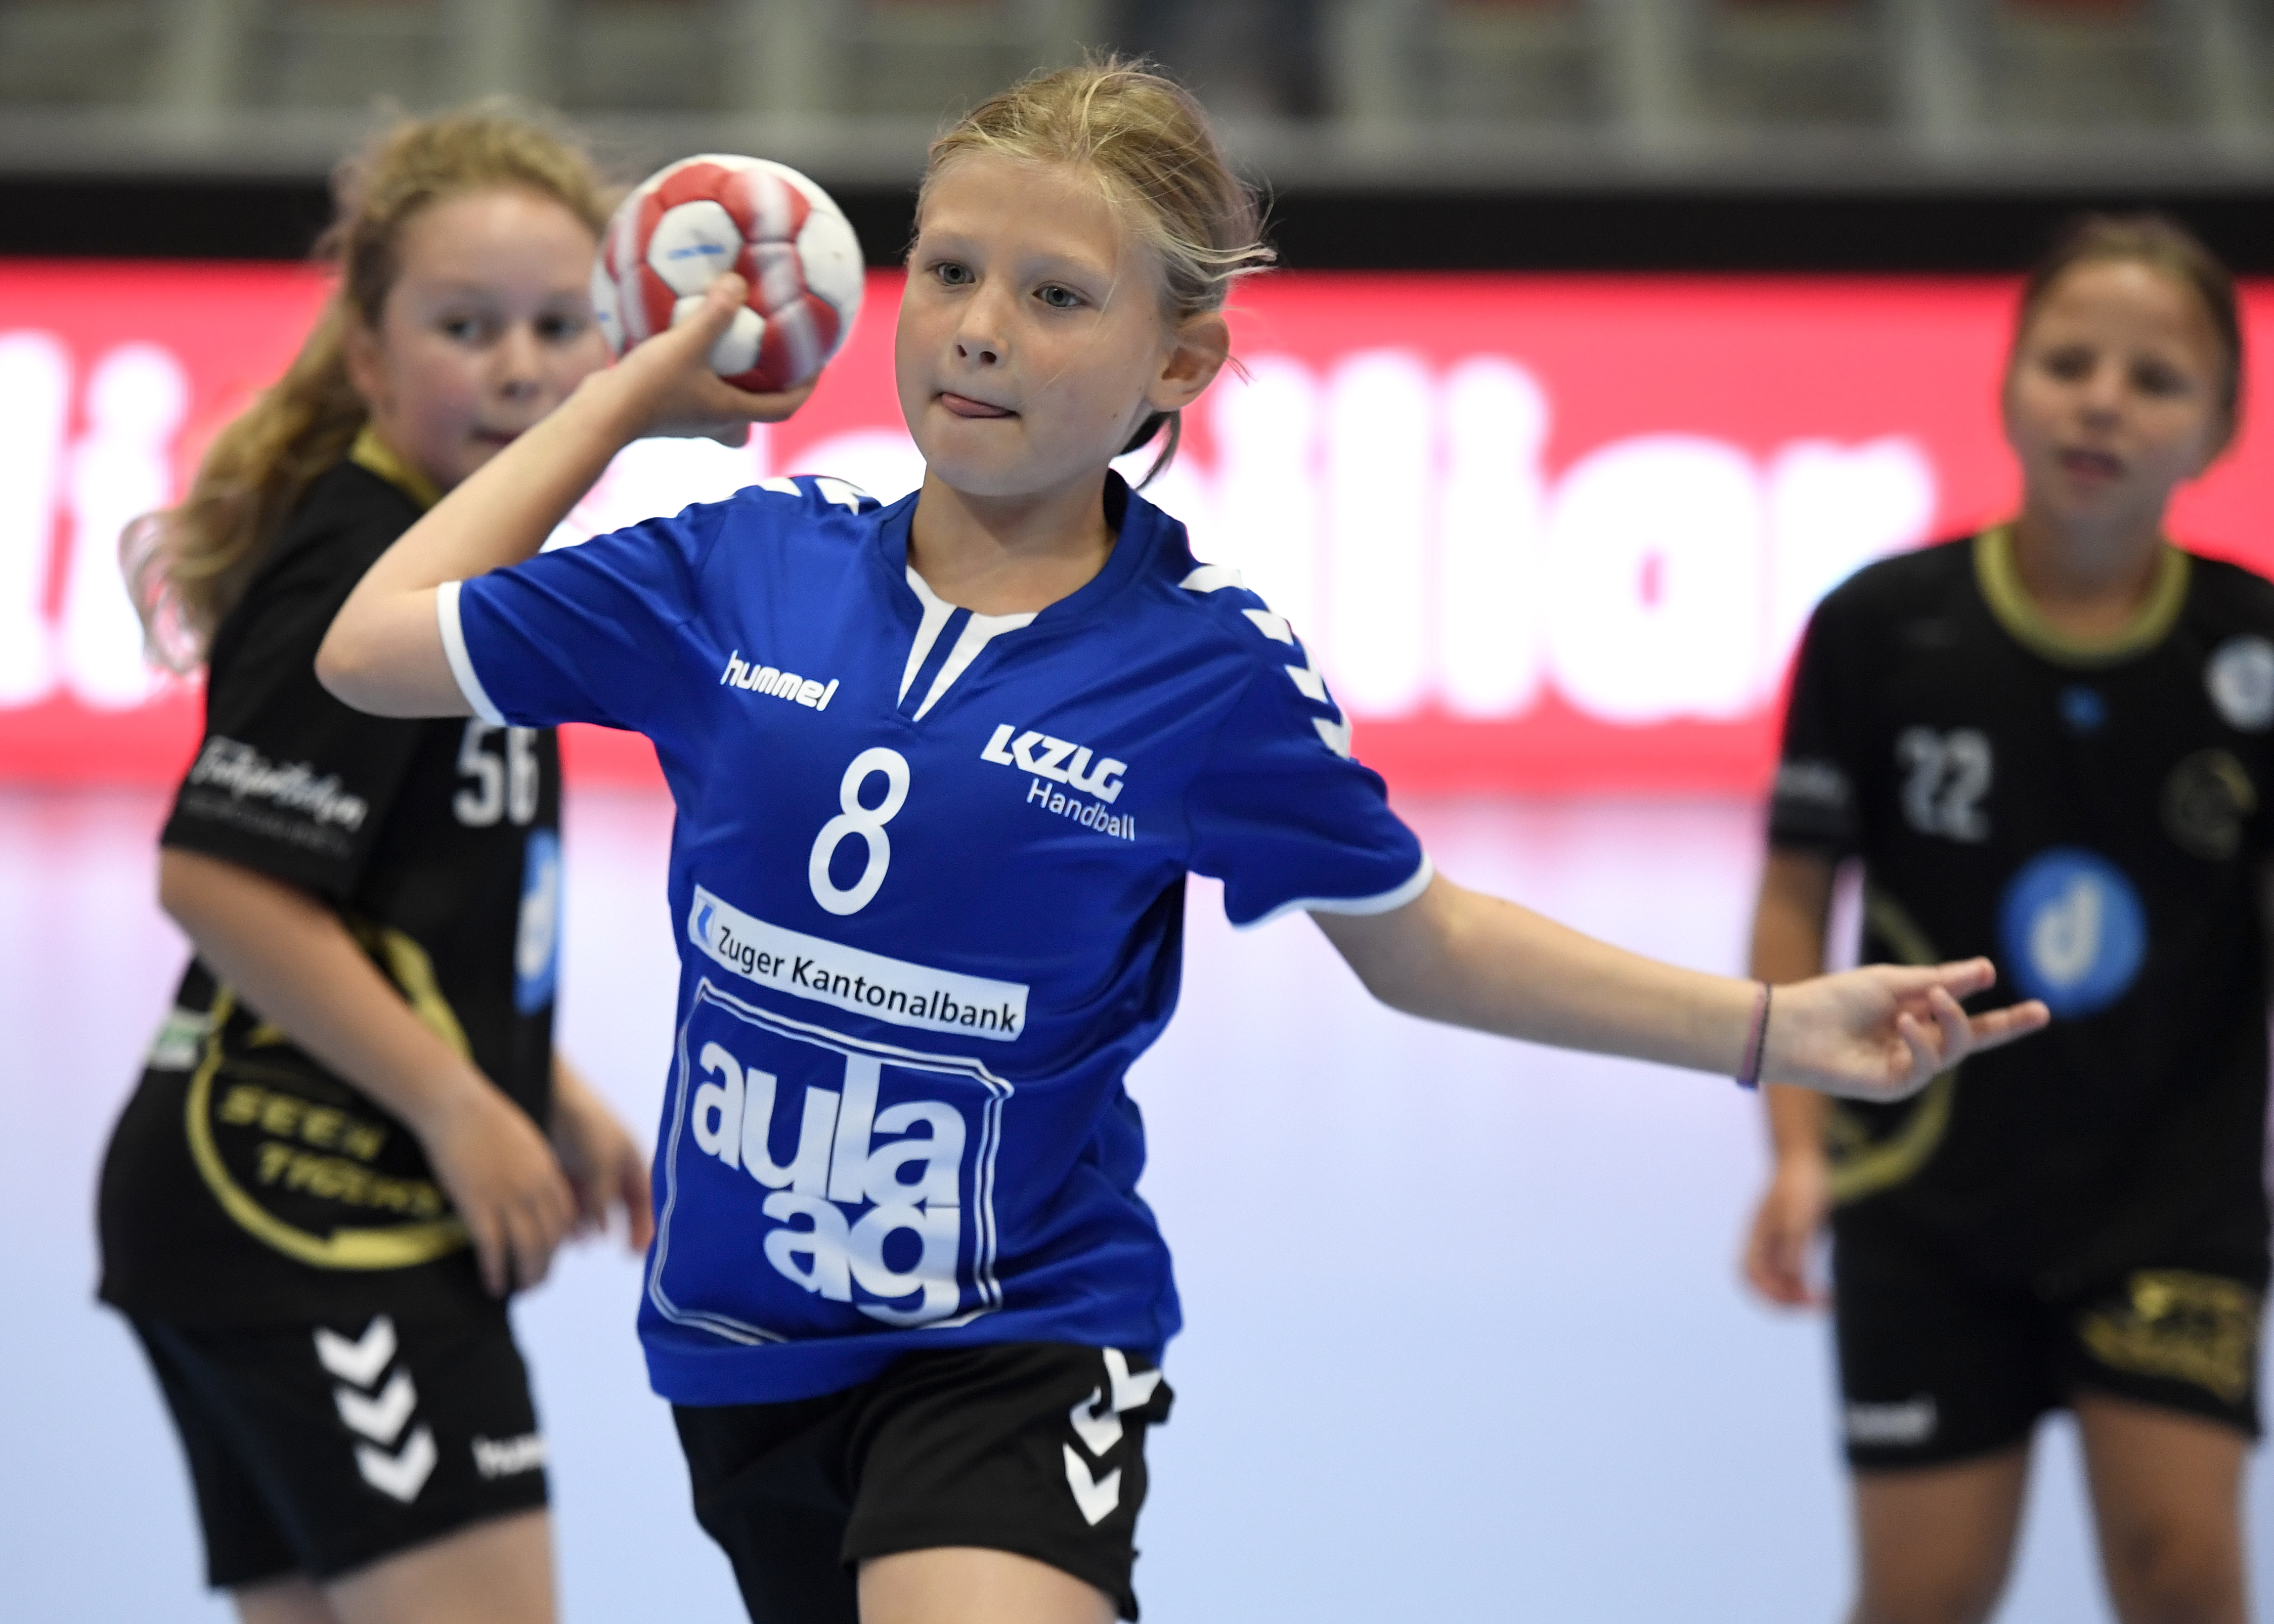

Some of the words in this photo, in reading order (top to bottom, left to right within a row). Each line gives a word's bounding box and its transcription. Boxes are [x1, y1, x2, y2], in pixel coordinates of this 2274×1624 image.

[719, 649, 839, 711] hummel
[809, 747, 910, 915] 8
[1026, 777, 1134, 842] Handball
[1897, 727, 1992, 842] 22
[718, 926, 784, 978] Zuger
[791, 956, 1017, 1033] Kantonalbank
[691, 1042, 967, 1208] aula
[762, 1191, 961, 1328] ag
